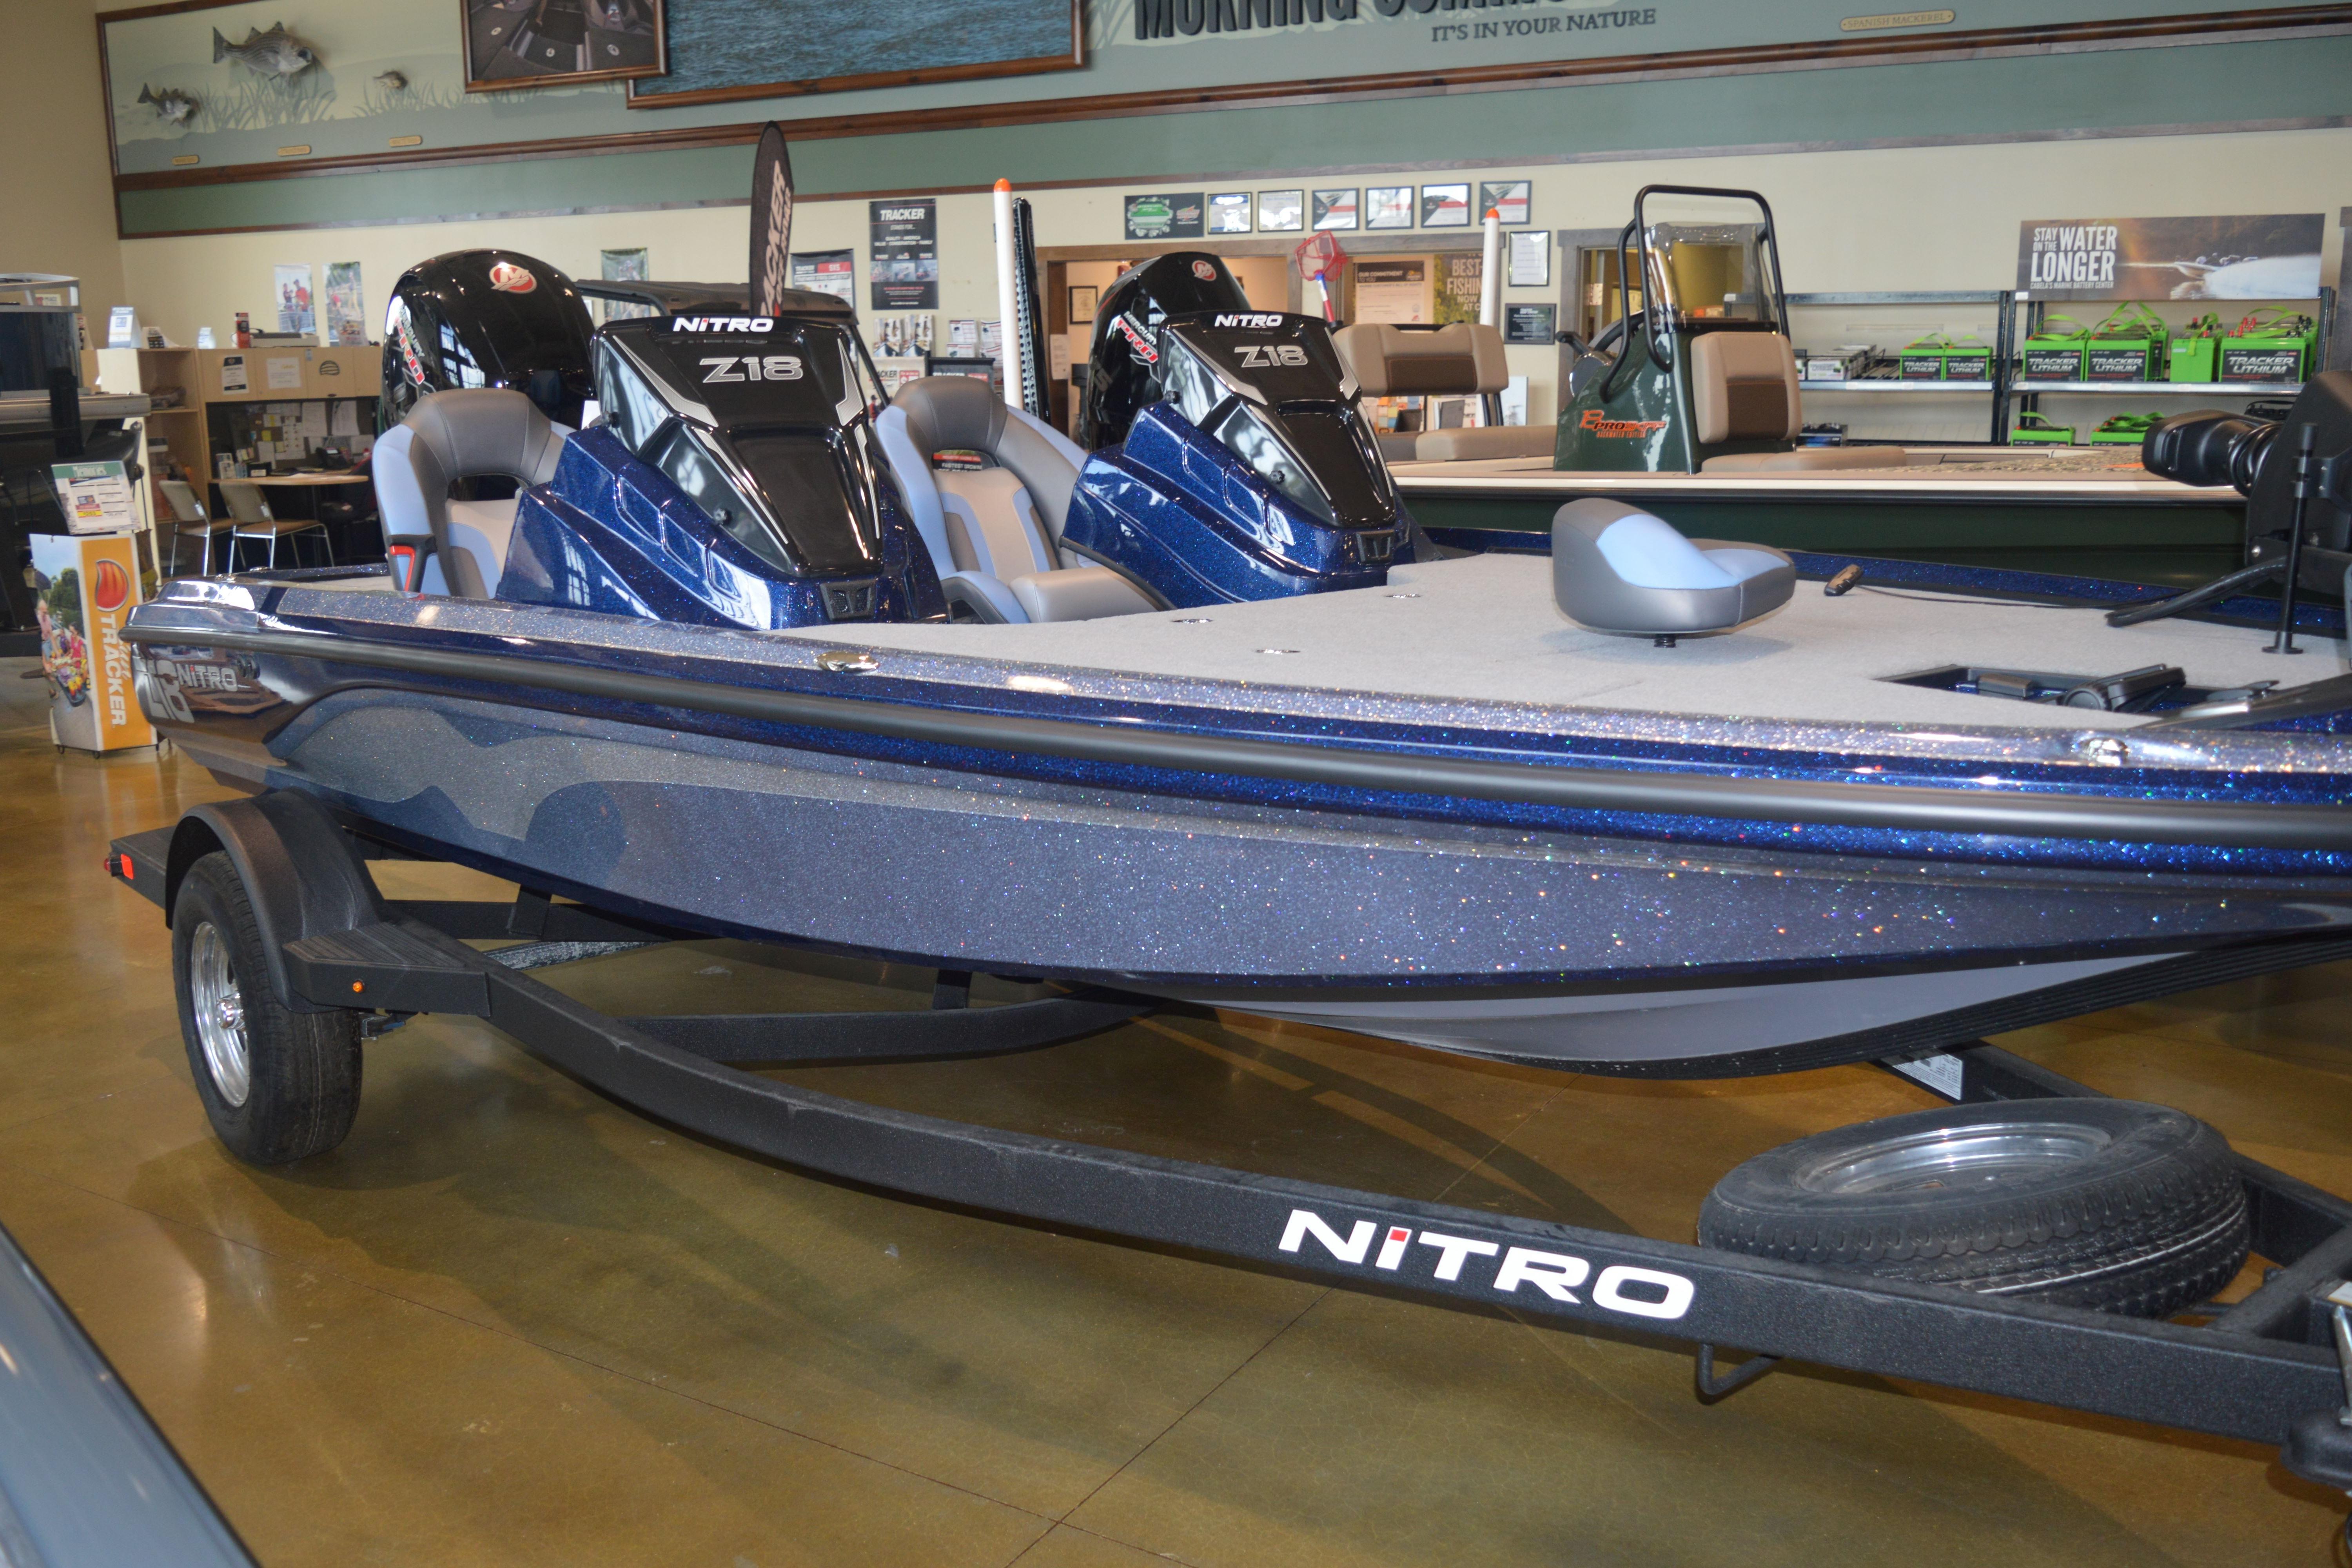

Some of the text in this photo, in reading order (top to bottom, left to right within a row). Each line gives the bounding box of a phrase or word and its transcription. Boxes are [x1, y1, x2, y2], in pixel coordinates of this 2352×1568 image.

[1432, 9, 1657, 42] IT'S IN YOUR NATURE
[1847, 13, 1945, 28] SPANISH MACKEREL
[880, 208, 925, 221] TRACKER
[2033, 227, 2058, 241] STAY
[2059, 226, 2118, 251] WATER
[2033, 241, 2058, 251] ON THE
[2031, 250, 2115, 282] LONGER
[1117, 317, 1158, 363] PRO
[1234, 345, 1308, 368] Z18
[2028, 358, 2078, 366] TRACKER
[2091, 358, 2143, 367] TRACKER
[2228, 357, 2295, 367] TRACKER
[699, 356, 804, 383] Z18
[2233, 365, 2287, 374] LITHIUM
[101, 614, 127, 725] TRACKER
